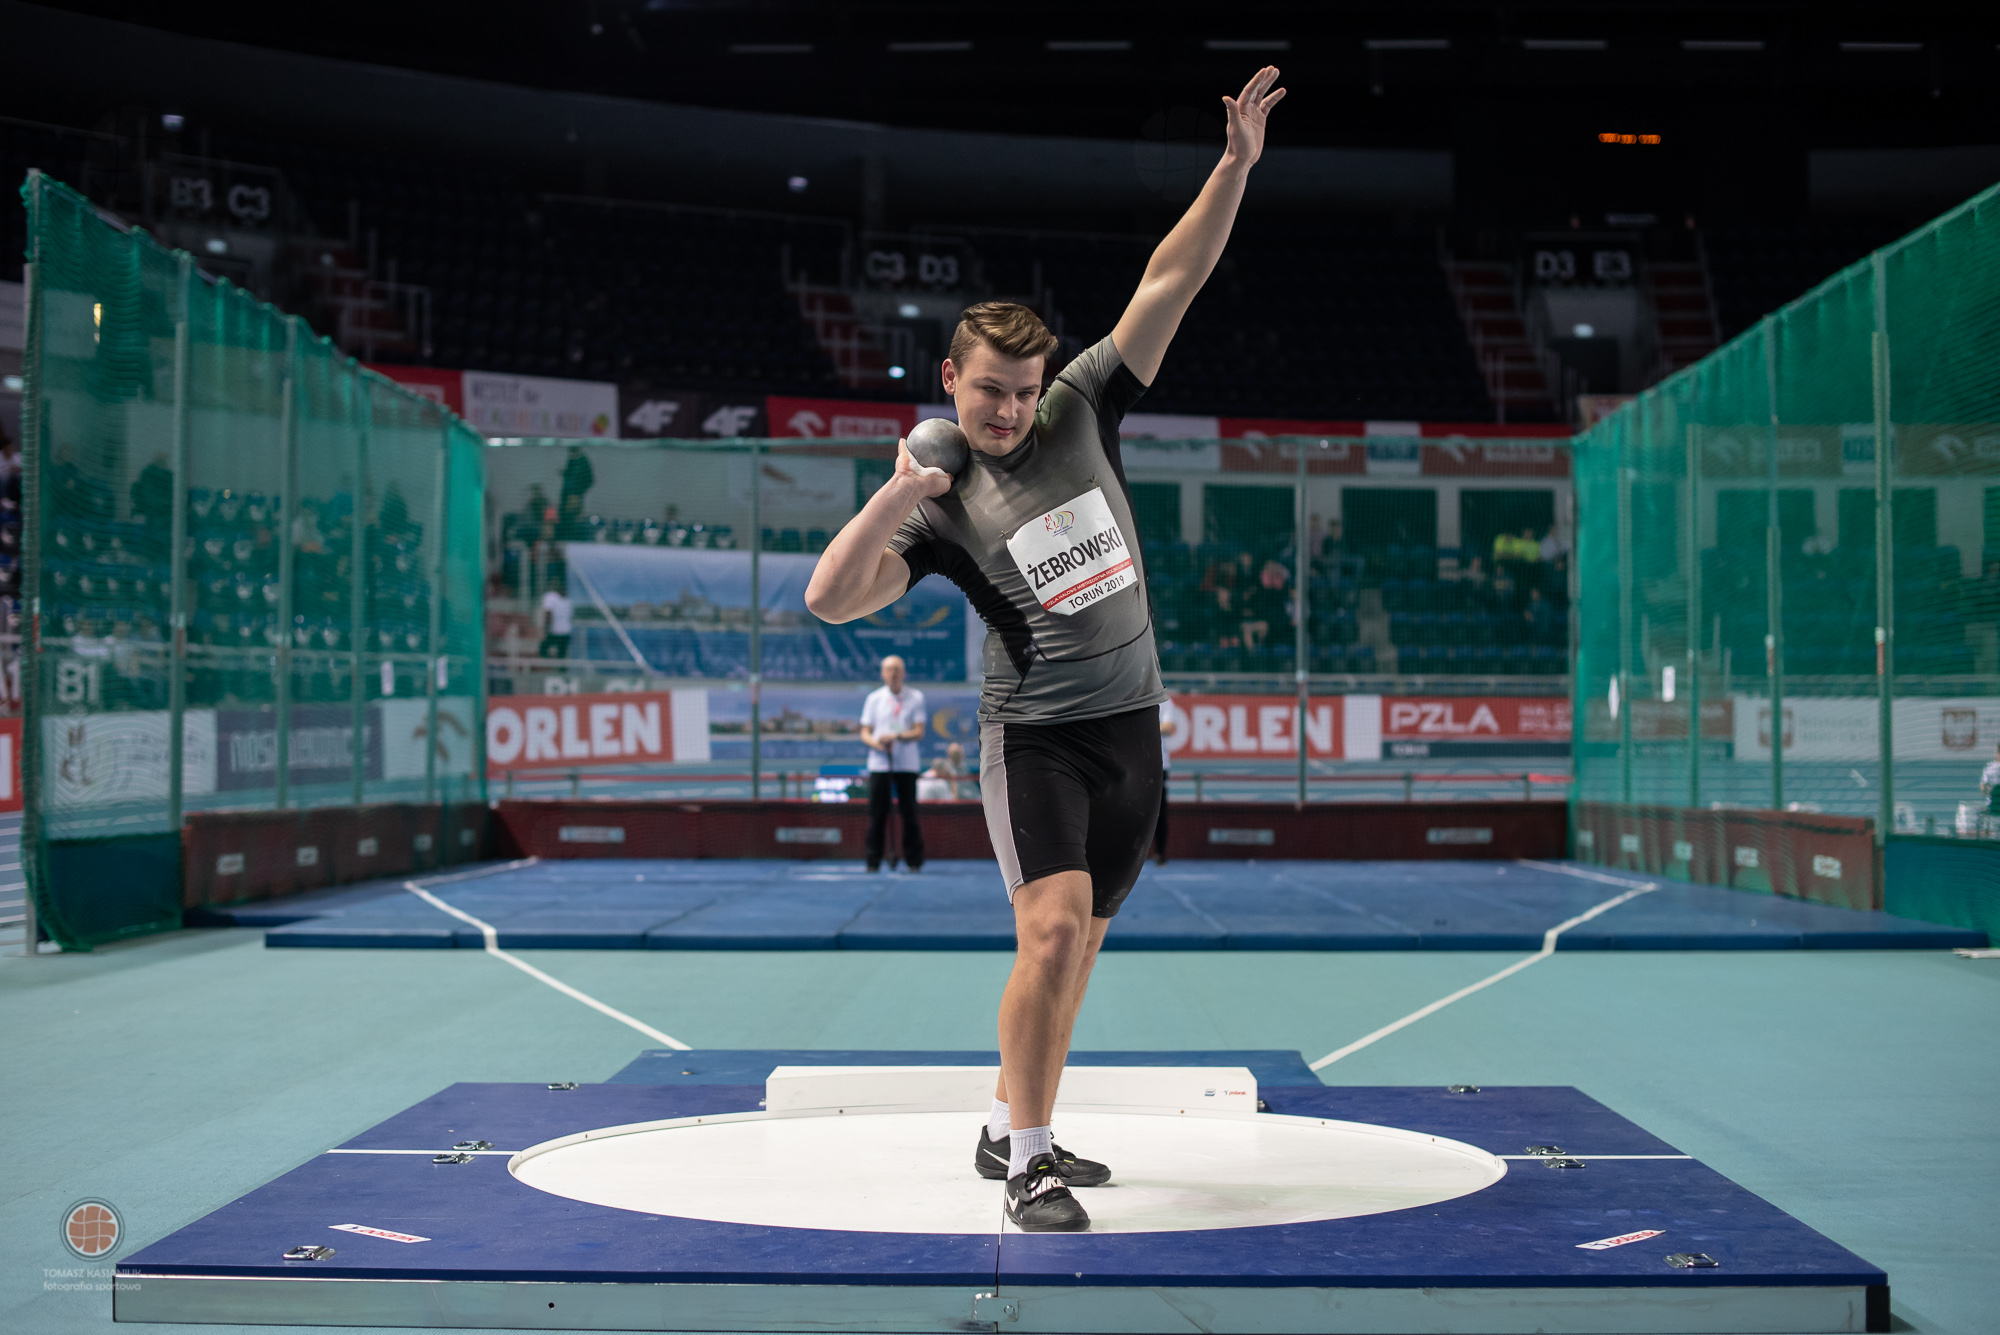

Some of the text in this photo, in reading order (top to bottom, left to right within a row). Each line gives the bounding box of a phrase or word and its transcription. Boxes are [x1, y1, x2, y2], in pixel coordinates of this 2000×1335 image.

[628, 400, 679, 433] 4F
[701, 405, 757, 435] 4F
[1027, 526, 1123, 590] ŻEBROWSKI
[1068, 575, 1125, 609] TORUŃ 2019
[486, 701, 662, 764] ORLEN
[1390, 702, 1499, 734] PZLA
[1031, 1176, 1066, 1198] NIKE
